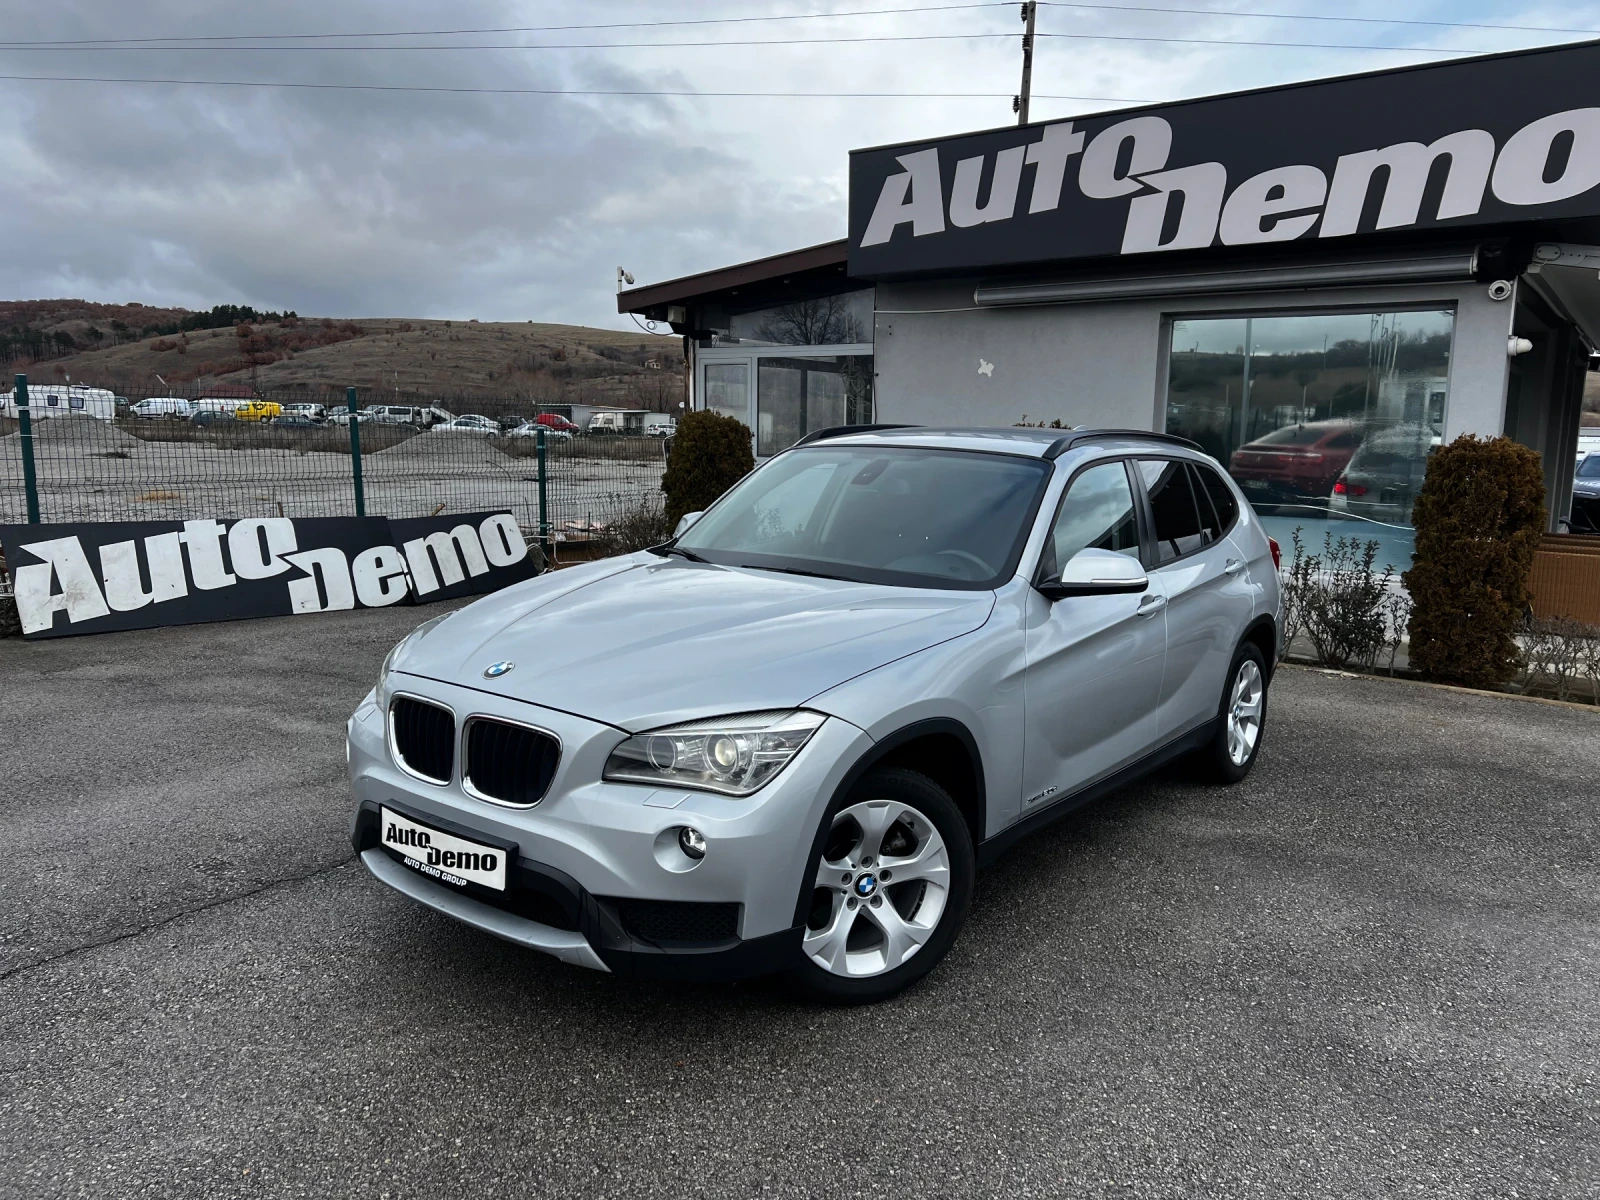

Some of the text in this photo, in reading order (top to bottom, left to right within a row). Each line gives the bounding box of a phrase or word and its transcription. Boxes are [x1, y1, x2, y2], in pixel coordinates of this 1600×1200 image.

[859, 107, 1600, 255] Auto Demo
[14, 514, 528, 635] Auto Demo
[386, 823, 498, 871] Auto Demo
[403, 856, 468, 887] AUTO DEMO GROUP
